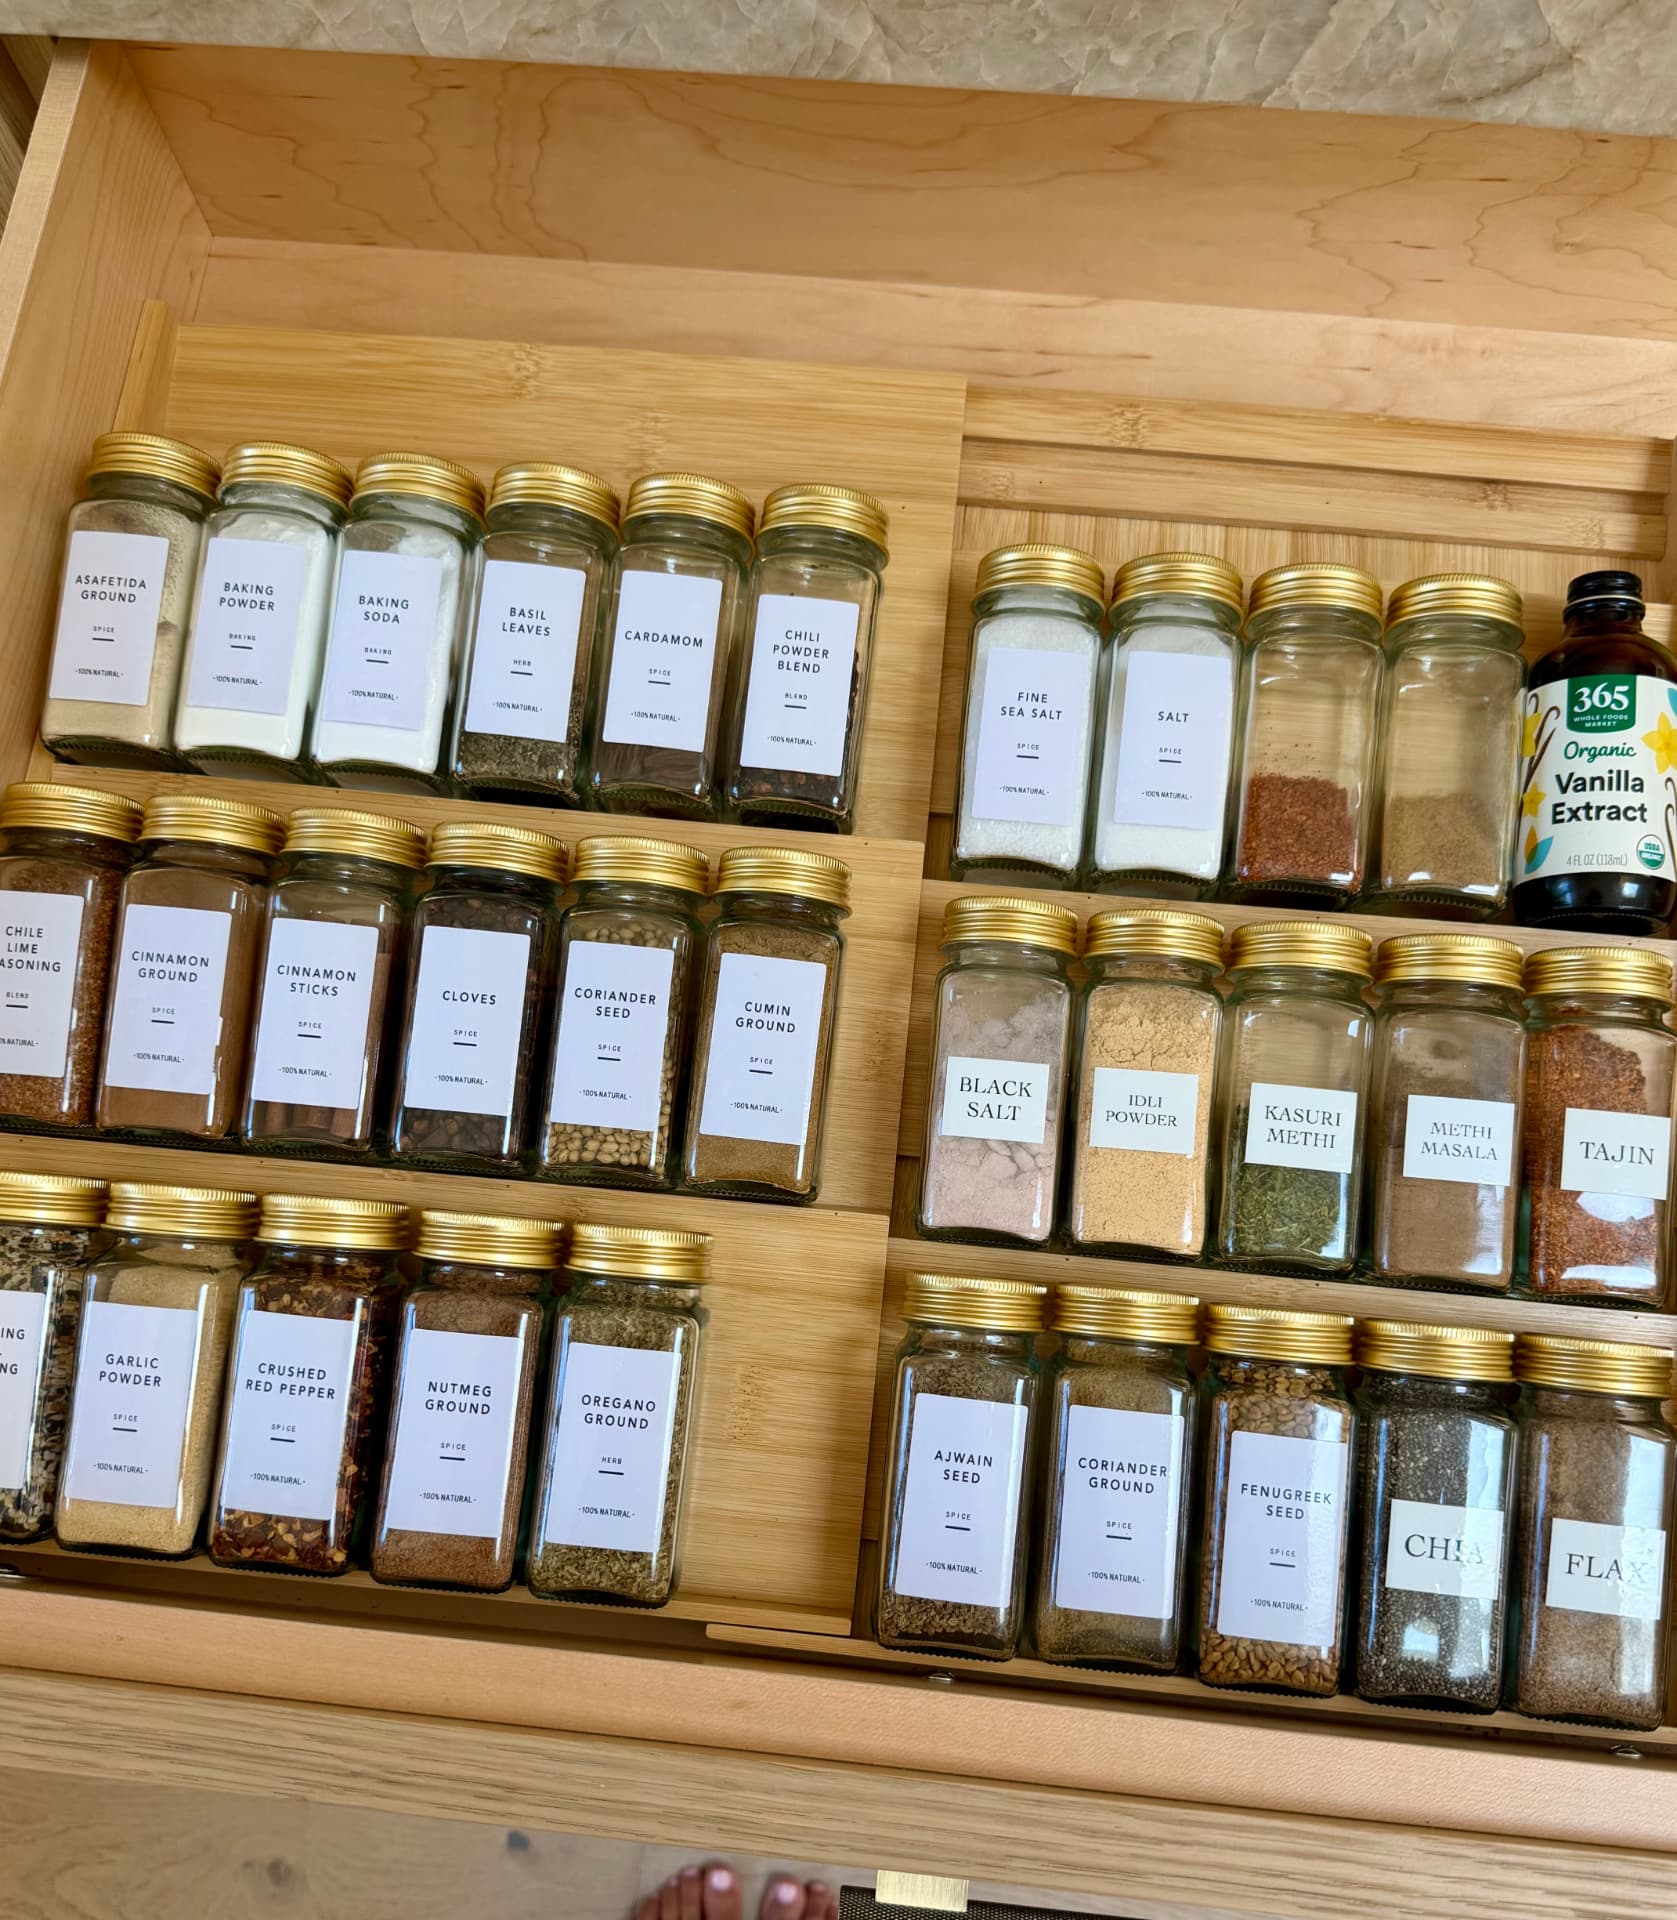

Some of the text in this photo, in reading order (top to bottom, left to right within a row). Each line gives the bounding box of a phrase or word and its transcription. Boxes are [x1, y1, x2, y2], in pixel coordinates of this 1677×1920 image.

[75, 575, 146, 589] ASAFETIDA
[224, 582, 273, 596] BAKING
[81, 590, 136, 603] GROUND
[219, 597, 274, 611] POWDER
[359, 595, 409, 610] BAKING
[364, 611, 400, 624] SODA
[510, 607, 546, 620] BASIL
[502, 622, 550, 636] LEAVES
[785, 630, 820, 642] CHILI
[229, 633, 256, 641] BAKING
[625, 630, 703, 648] CARDAMOM
[364, 647, 392, 655] BAKING
[773, 644, 829, 659] POWDER
[649, 668, 671, 676] SPICE
[778, 660, 820, 673] BLEND
[1018, 692, 1047, 703] FINE
[1573, 682, 1630, 713] 365
[1001, 706, 1062, 720] SEA SALT
[1158, 711, 1189, 722] SALT
[1159, 747, 1181, 755] SPICE
[1563, 741, 1637, 764] Organic
[1555, 769, 1645, 795] Vanilla
[1551, 801, 1648, 825] Extract
[1566, 855, 1572, 866] 4
[1573, 855, 1582, 866] FL
[1583, 854, 1595, 866] OZ
[5, 926, 43, 938] CHILE
[7, 942, 38, 954] LIME
[132, 951, 209, 967] CINNAMON
[138, 968, 198, 982] GROUND
[277, 965, 356, 982] CINNAMON
[290, 982, 338, 996] STICKS
[574, 987, 656, 1005] CORIANDER
[442, 990, 496, 1005] CLOVES
[152, 1007, 175, 1015] SPICE
[596, 1006, 630, 1018] SEED
[745, 1001, 790, 1016] CUMIN
[298, 1021, 321, 1029] SPICE
[736, 1017, 795, 1033] GROUND
[454, 1029, 478, 1037] SPICE
[598, 1044, 621, 1052] SPICE
[750, 1056, 773, 1065] SPICE
[960, 1077, 1032, 1097] BLACK
[1129, 1095, 1162, 1108] IDLI
[967, 1102, 1021, 1121] SALT
[1106, 1110, 1177, 1127] POWDER
[1265, 1105, 1340, 1127] KASURI
[1430, 1122, 1491, 1139] METHI
[1267, 1128, 1336, 1149] METHI
[1421, 1141, 1497, 1160] MASALA
[1580, 1141, 1654, 1165] TAJIN
[106, 1353, 158, 1369] GARLIC
[99, 1371, 161, 1387] POWDER
[258, 1363, 326, 1380] CRUSHED
[246, 1379, 335, 1399] RED PEPPER
[428, 1381, 491, 1397] NUTMEG
[425, 1399, 490, 1415] GROUND
[581, 1394, 656, 1412] OREGANO
[113, 1413, 138, 1422] SPICE
[584, 1413, 648, 1429] GROUND
[271, 1424, 296, 1432] SPICE
[440, 1442, 466, 1451] SPICE
[934, 1450, 992, 1467] AJWAIN
[1078, 1457, 1167, 1477] CORIANDER
[943, 1469, 980, 1484] SEED
[1089, 1476, 1154, 1494] GROUND
[1241, 1483, 1331, 1504] FENUGREEK
[946, 1511, 971, 1520] SPICE
[1266, 1505, 1304, 1519] SEED
[1106, 1521, 1132, 1530] SPICE
[1270, 1548, 1295, 1557] SPICE
[1404, 1533, 1483, 1564] CHIA
[1565, 1552, 1649, 1584] FLAX
